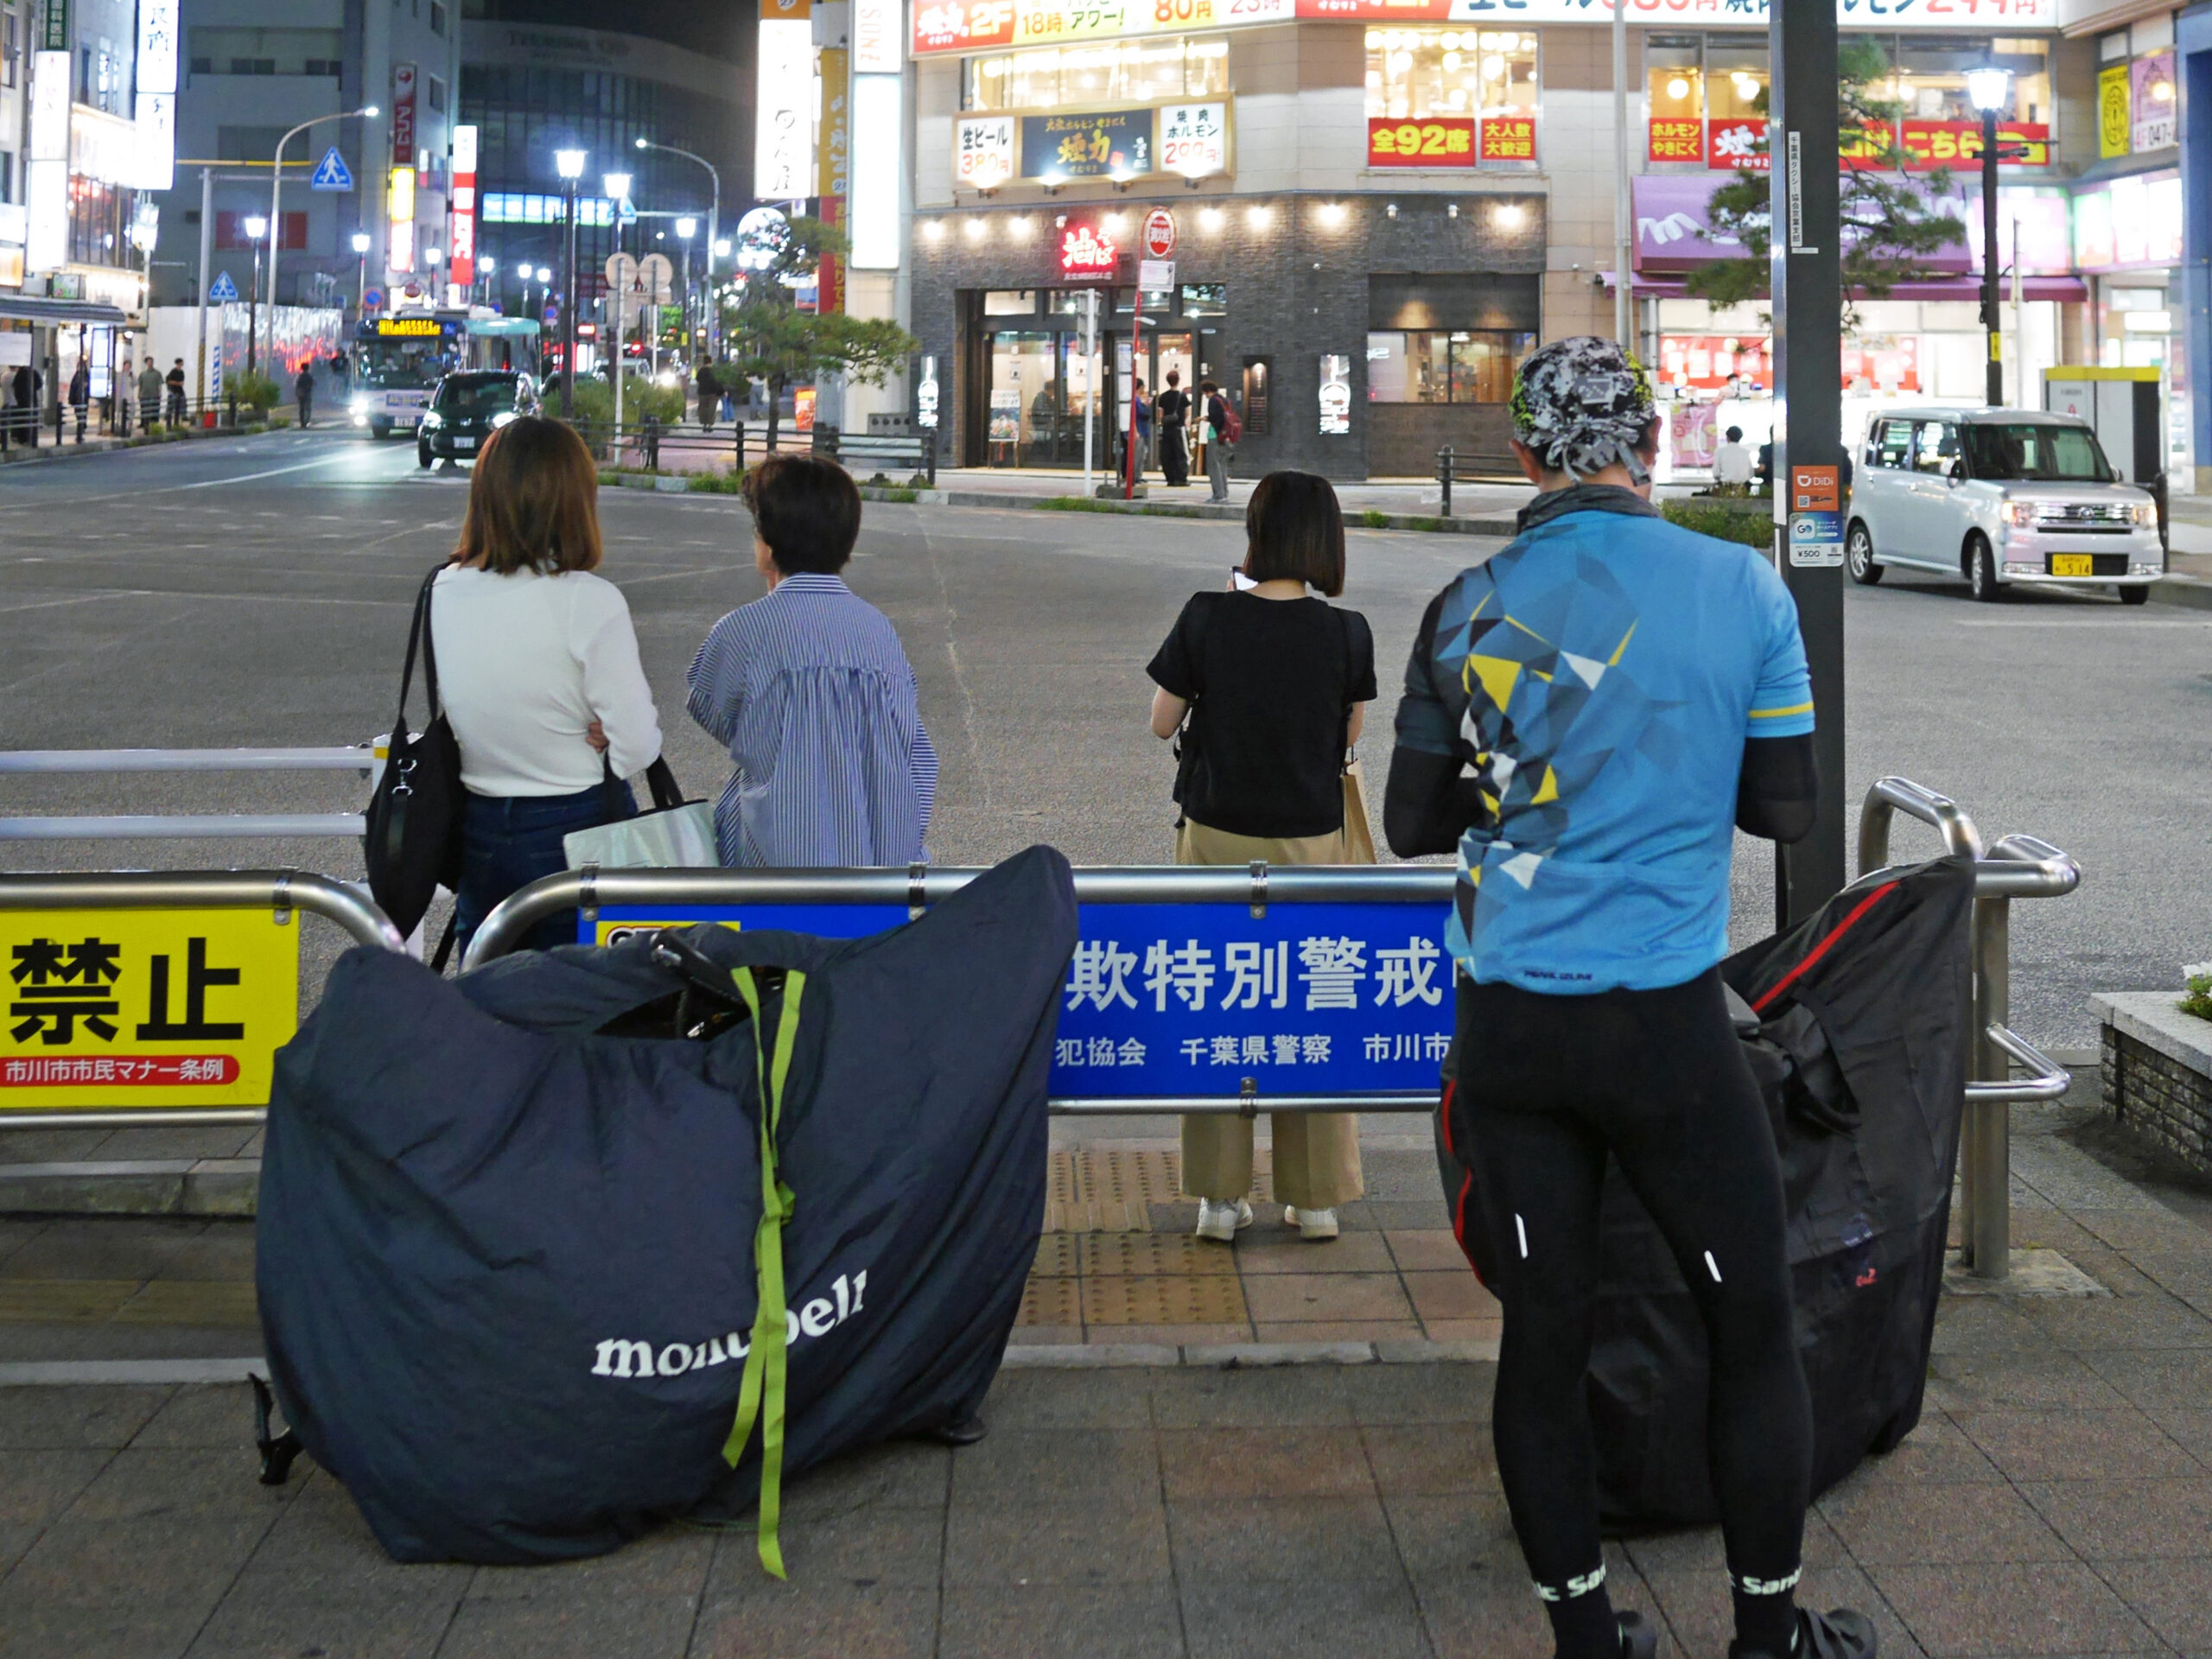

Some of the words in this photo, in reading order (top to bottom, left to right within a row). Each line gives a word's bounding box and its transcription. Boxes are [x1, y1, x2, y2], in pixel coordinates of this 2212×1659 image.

[970, 3, 1012, 36] 2F
[963, 124, 1008, 150] 生ビール
[1167, 124, 1218, 138] ホルモン
[1484, 123, 1531, 137] 大人数
[1651, 123, 1700, 137] ホルモン
[1371, 124, 1471, 156] 全92席
[1484, 141, 1531, 156] 大歓迎
[1651, 142, 1699, 156] やきにく
[1813, 476, 1834, 486] DiDi
[1797, 550, 1821, 558] ¥500
[9, 937, 245, 1046] 禁止
[1056, 1036, 1147, 1067] 犯協会
[1180, 1033, 1332, 1066] 千葉県警察
[1363, 1031, 1452, 1063] 市川市
[5, 1058, 225, 1083] 市川市市民マナー条例
